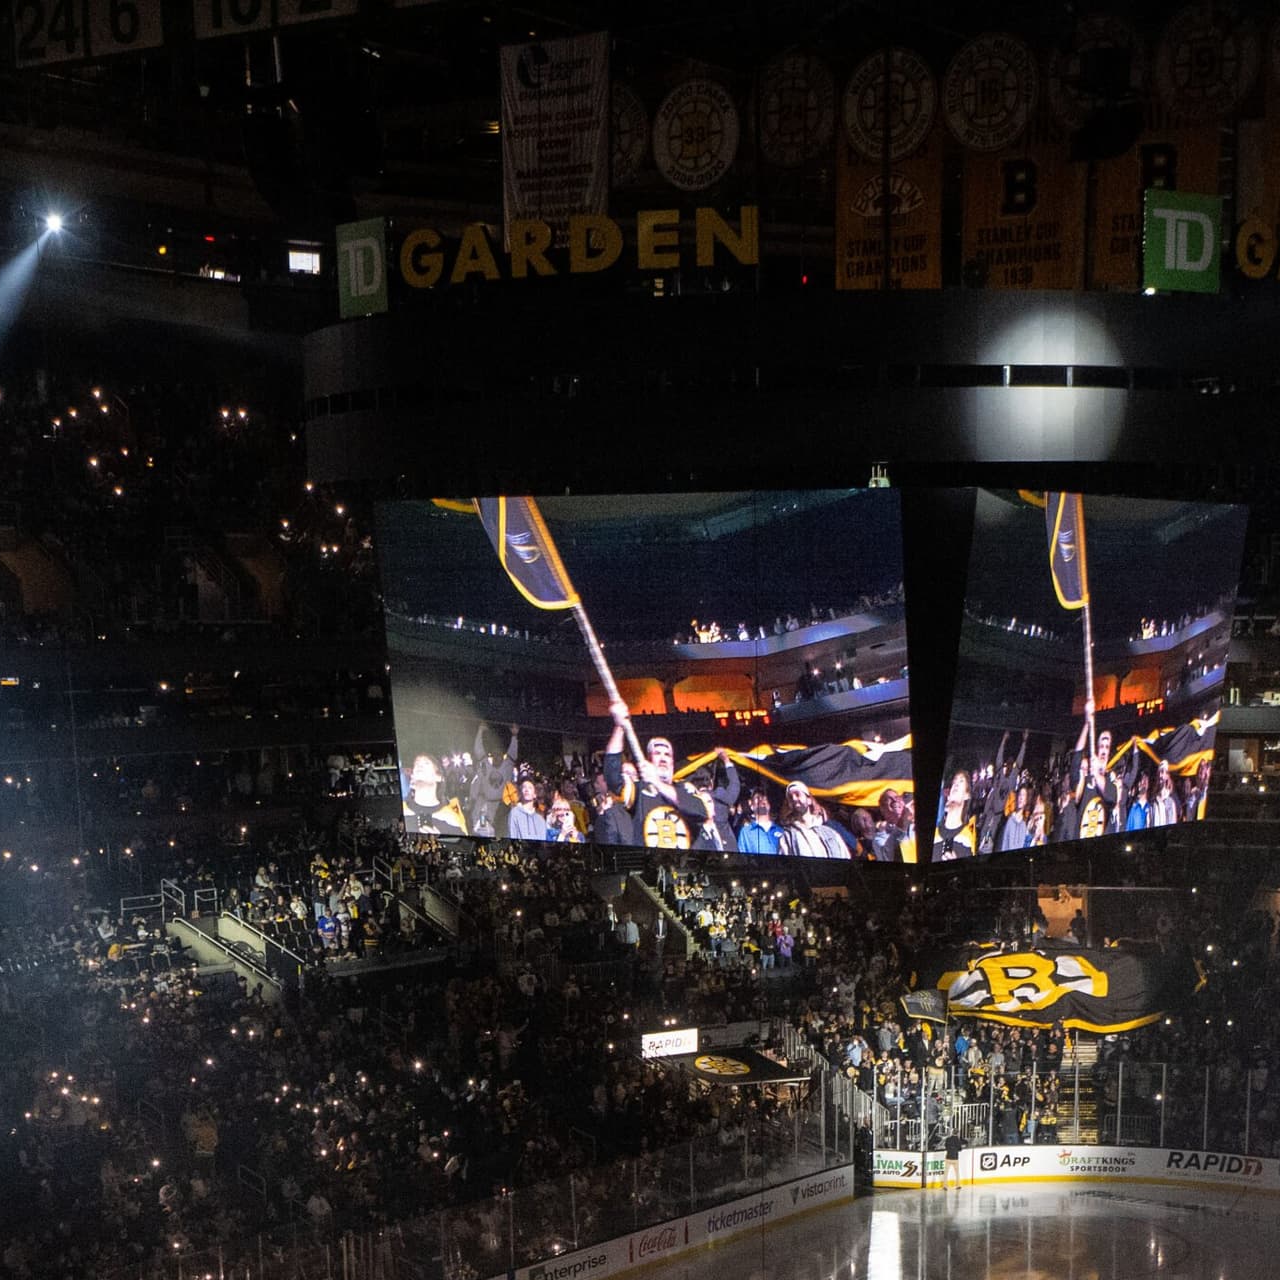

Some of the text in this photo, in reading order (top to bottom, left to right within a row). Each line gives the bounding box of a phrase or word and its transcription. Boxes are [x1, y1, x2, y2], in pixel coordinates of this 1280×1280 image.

[685, 126, 706, 145] 33
[342, 205, 761, 299] TD GARDEN
[1152, 207, 1217, 274] TD
[1070, 1164, 1127, 1173] SPORTSBOOK
[800, 1173, 847, 1200] vistaprint
[707, 1200, 775, 1234] ticketmaster
[638, 1227, 678, 1258] Coca-Cola
